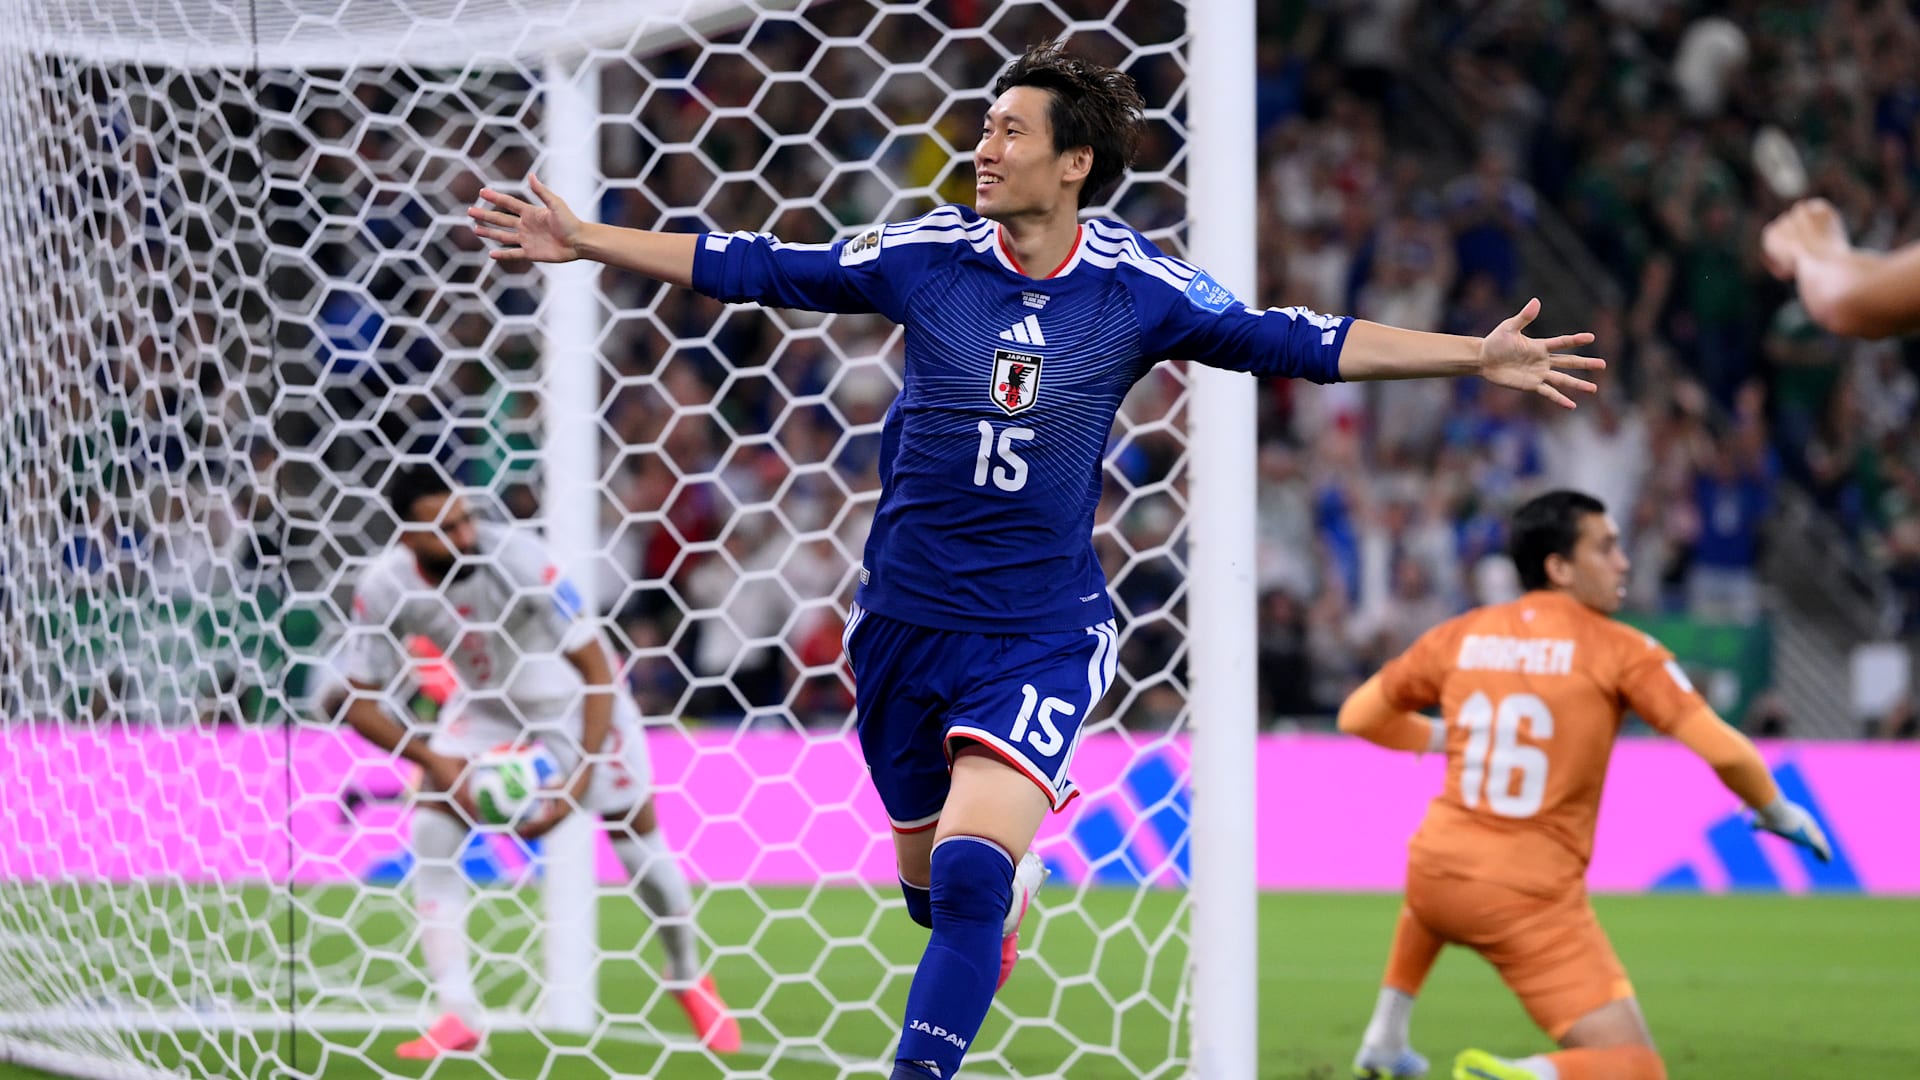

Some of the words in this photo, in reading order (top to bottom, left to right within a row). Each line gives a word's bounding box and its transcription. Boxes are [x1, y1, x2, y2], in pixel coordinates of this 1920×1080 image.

[1006, 353, 1032, 363] JAPAN
[1001, 393, 1022, 405] JFA
[973, 420, 1035, 492] 15
[1009, 683, 1076, 757] 15
[1457, 690, 1555, 819] 16
[909, 1019, 967, 1050] JAPAN
